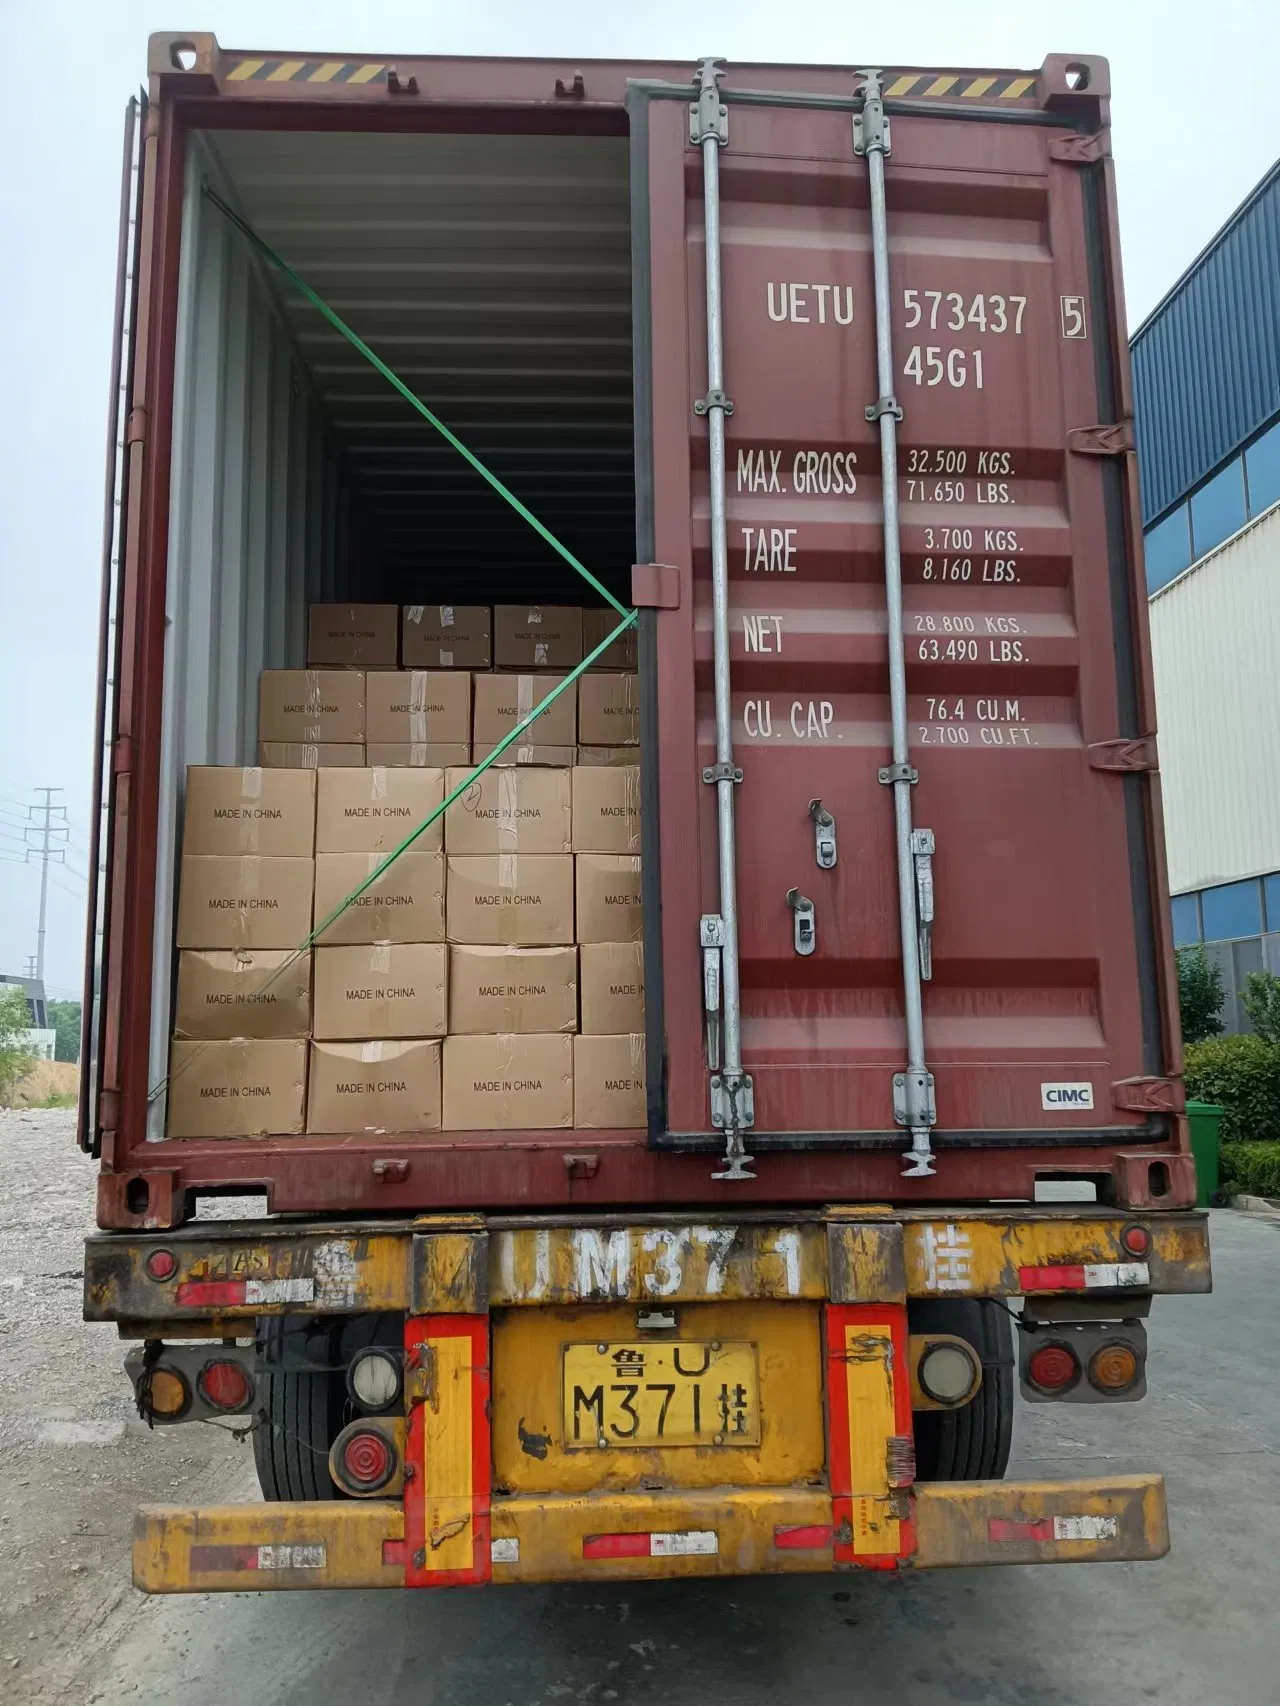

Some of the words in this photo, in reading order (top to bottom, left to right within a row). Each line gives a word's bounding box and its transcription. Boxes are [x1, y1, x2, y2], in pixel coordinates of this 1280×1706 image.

[768, 282, 854, 324] UETU
[904, 289, 1027, 334] 573437
[1064, 298, 1082, 336] 5
[903, 345, 983, 389] 45G1
[977, 451, 1015, 475] KGS.
[737, 449, 786, 493] MAX.
[793, 451, 857, 494] GROSS
[977, 482, 1015, 504] LBS.
[984, 530, 1024, 552] KGS.
[742, 527, 797, 572] TARE
[982, 559, 1021, 582] LBS.
[985, 617, 1028, 634] KGS.
[743, 615, 783, 653] NET
[990, 641, 1029, 662] LBS.
[284, 704, 305, 713] MADE
[317, 704, 340, 713] CHINA
[390, 704, 411, 713] MADE
[423, 704, 445, 713] CHINA
[497, 707, 518, 716] MADE
[927, 698, 964, 720] 76.4
[976, 700, 1026, 721] CU.M.
[744, 700, 782, 737] CU.
[791, 701, 843, 738] CAP.
[980, 728, 1039, 745] CU.FT.
[214, 809, 240, 819] MADE
[242, 809, 251, 818] IN
[254, 809, 282, 819] CHINA
[344, 808, 370, 817] MADE
[373, 808, 381, 817] IN
[383, 807, 411, 817] CHINA
[475, 809, 500, 819] MADE
[502, 809, 512, 818] IN
[514, 809, 541, 818] CHINA
[600, 807, 625, 816] MADE
[628, 807, 637, 816] IN
[208, 900, 235, 909] MADE
[238, 900, 247, 909] IN
[250, 899, 278, 909] CHINA
[374, 896, 383, 906] IN
[385, 895, 414, 906] CHINA
[474, 896, 500, 905] MADE
[502, 896, 512, 905] IN
[514, 895, 542, 905] CHINA
[605, 895, 630, 905] MADE
[632, 895, 641, 905] IN
[346, 990, 373, 1000] MADE
[375, 989, 385, 999] IN
[387, 988, 415, 999] CHINA
[479, 986, 504, 996] MADE
[507, 986, 516, 995] IN
[518, 986, 546, 996] CHINA
[610, 984, 636, 995] MADE
[206, 994, 233, 1004] MADE
[235, 994, 245, 1004] IN
[247, 994, 277, 1004] CHINA
[336, 1083, 363, 1094] MADE
[366, 1083, 375, 1093] IN
[377, 1082, 407, 1092] CHINA
[473, 1082, 500, 1092] MADE
[502, 1081, 512, 1091] IN
[514, 1080, 542, 1091] CHINA
[605, 1080, 631, 1090] MADE
[633, 1080, 643, 1090] IN
[200, 1088, 228, 1098] MADE
[230, 1087, 239, 1097] IN
[242, 1086, 271, 1097] CHINA
[1046, 1089, 1089, 1102] CIMC
[916, 1223, 972, 1290] 挂
